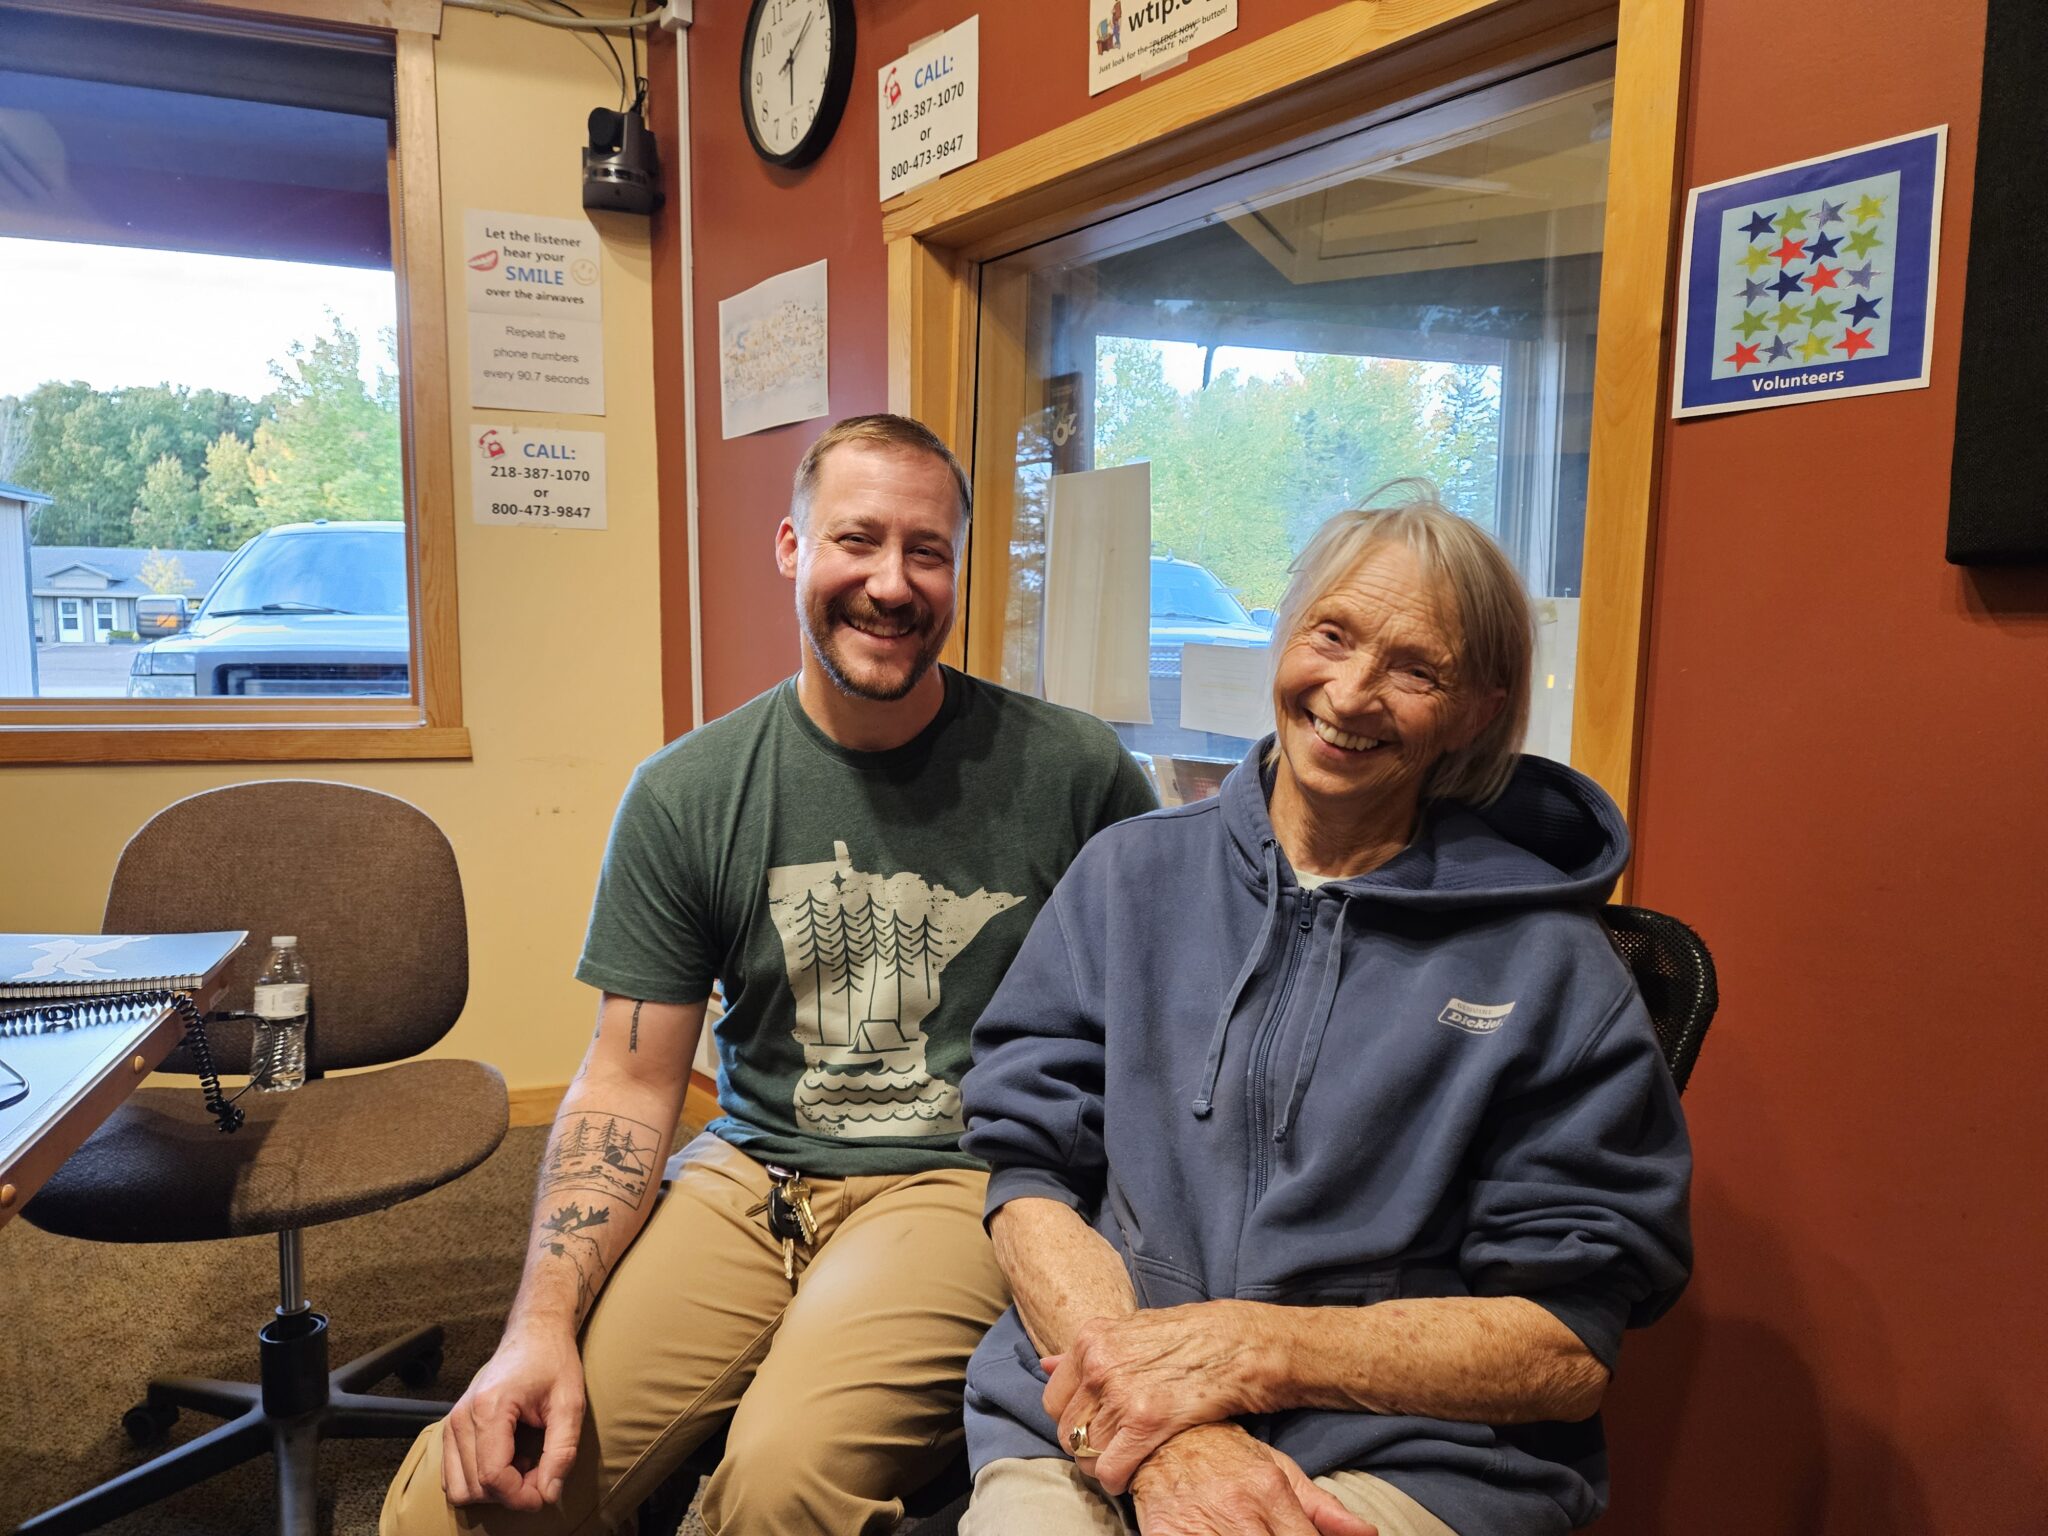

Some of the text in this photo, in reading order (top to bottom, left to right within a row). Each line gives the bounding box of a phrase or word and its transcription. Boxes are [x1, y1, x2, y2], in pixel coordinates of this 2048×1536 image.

[761, 31, 773, 58] 10
[1098, 63, 1111, 74] Just
[1112, 54, 1125, 68] look
[1127, 50, 1136, 61] for
[1137, 44, 1148, 56] the
[1201, 4, 1228, 24] button!
[914, 54, 954, 89] CALL:
[756, 71, 763, 94] 9
[762, 100, 768, 122] 8
[890, 81, 965, 131] 218-387-1070
[774, 118, 780, 140] 7
[791, 117, 798, 140] 6
[919, 125, 933, 142] or
[890, 134, 964, 181] 800-473-9847
[485, 227, 581, 248] Let the listener
[503, 246, 565, 264] hear your
[505, 266, 565, 286] SMILE
[485, 288, 585, 305] over the airwaves
[505, 326, 566, 341] Repeat the
[493, 348, 579, 363] phone numbers
[483, 369, 590, 386] every 90.7 seconds
[1752, 369, 1845, 392] Volunteers
[523, 443, 576, 460] CALL:
[490, 466, 590, 482] 218-387-1070
[533, 489, 549, 498] or
[491, 503, 591, 518] 800-473-9847
